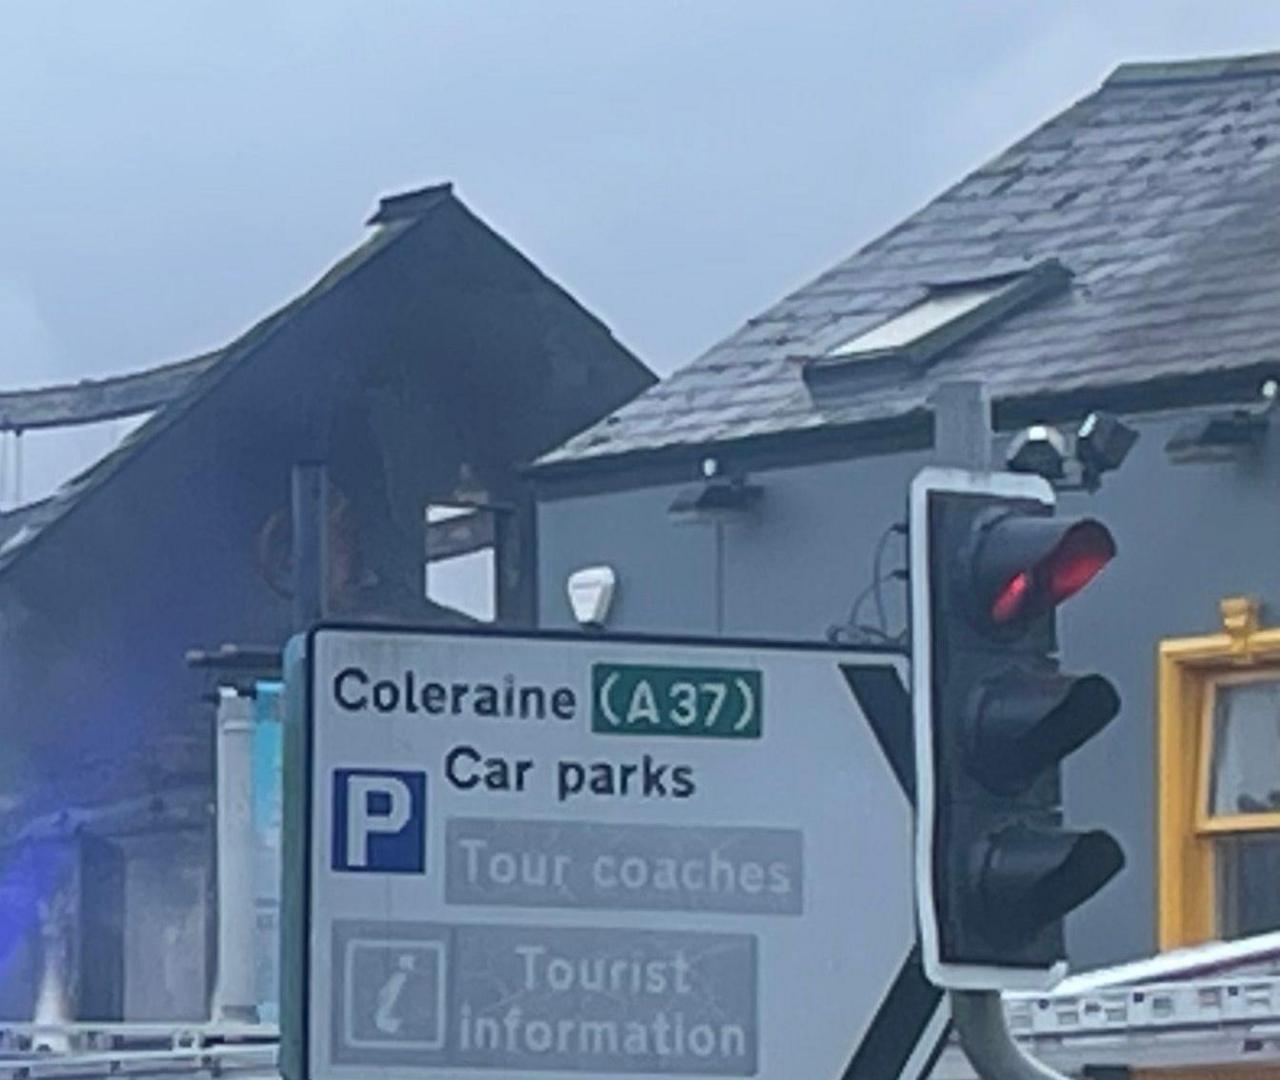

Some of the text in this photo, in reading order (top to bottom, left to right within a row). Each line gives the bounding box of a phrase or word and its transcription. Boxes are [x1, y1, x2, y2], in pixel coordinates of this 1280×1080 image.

[333, 666, 577, 720] Coleraine
[444, 745, 696, 801] Car parks
[459, 838, 791, 894] Tour coaches
[515, 944, 693, 995] Tourist
[459, 998, 747, 1057] information
